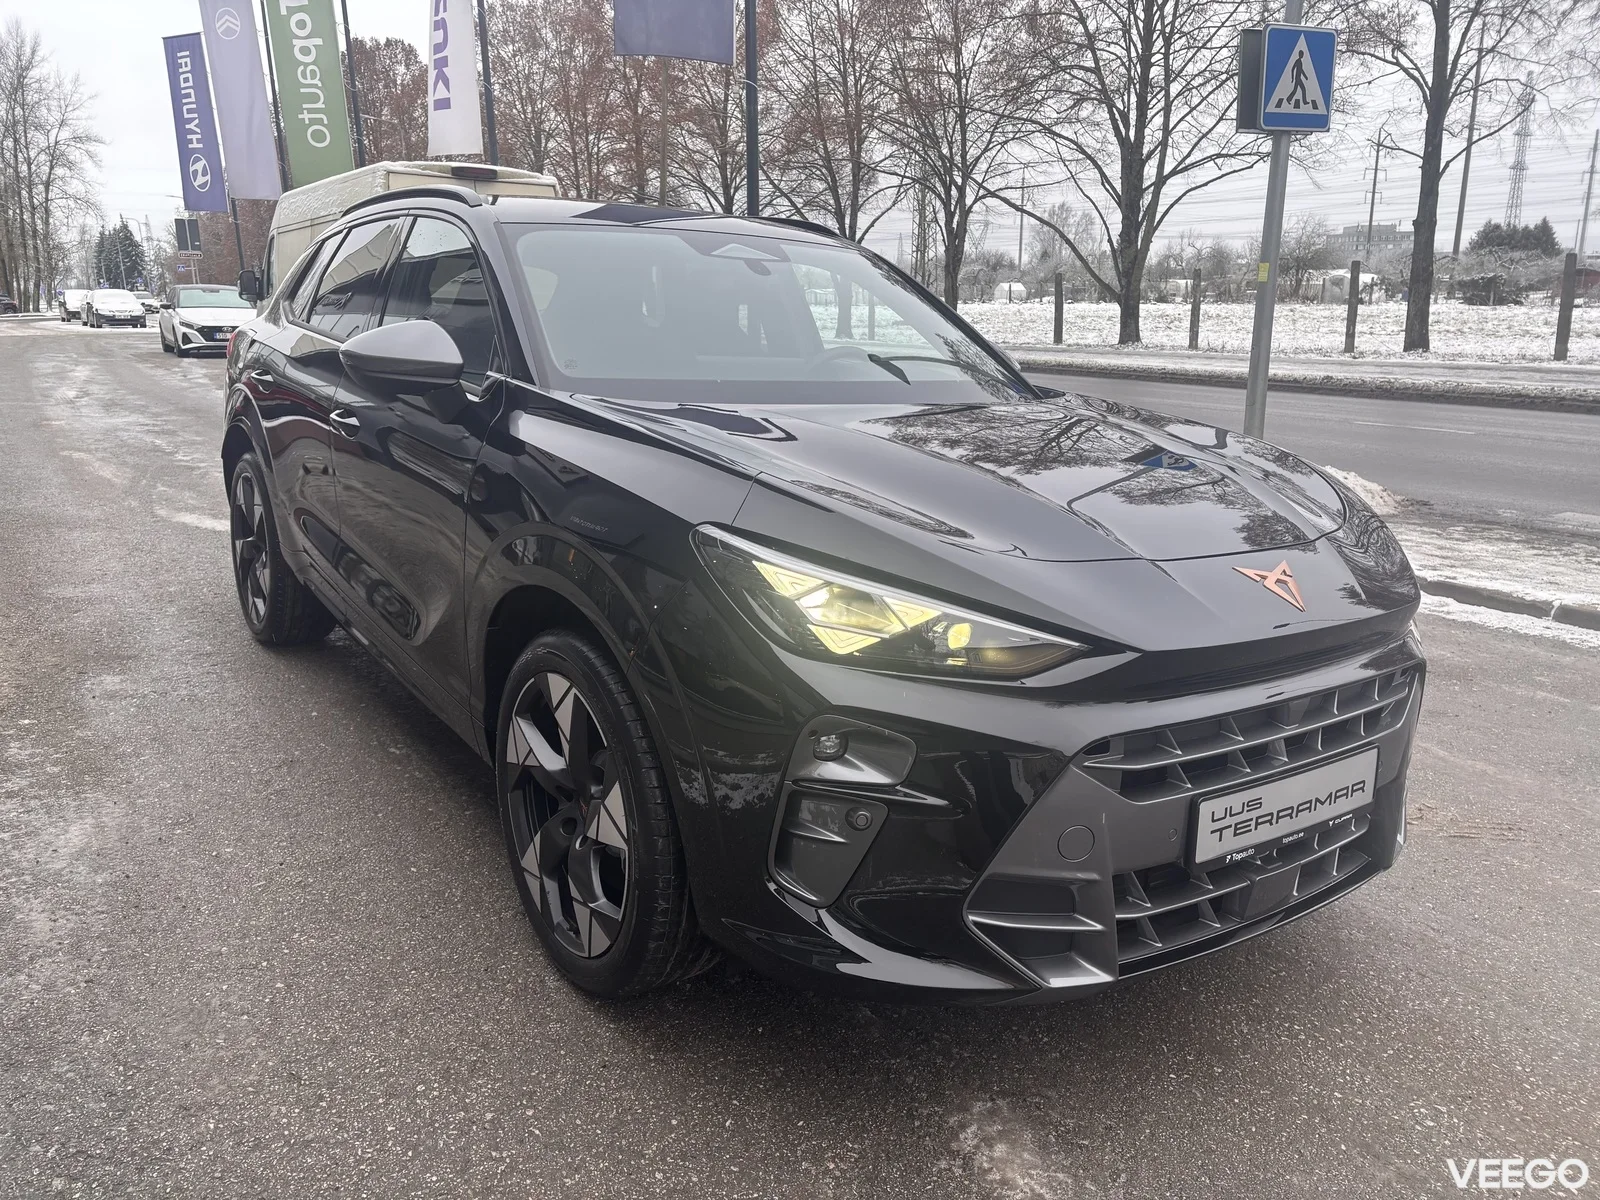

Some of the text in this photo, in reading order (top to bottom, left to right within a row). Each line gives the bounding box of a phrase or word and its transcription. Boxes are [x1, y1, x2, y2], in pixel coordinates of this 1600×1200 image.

[1210, 797, 1263, 823] UUS
[1210, 780, 1366, 843] TERRAMAR
[1232, 849, 1255, 861] Topauto
